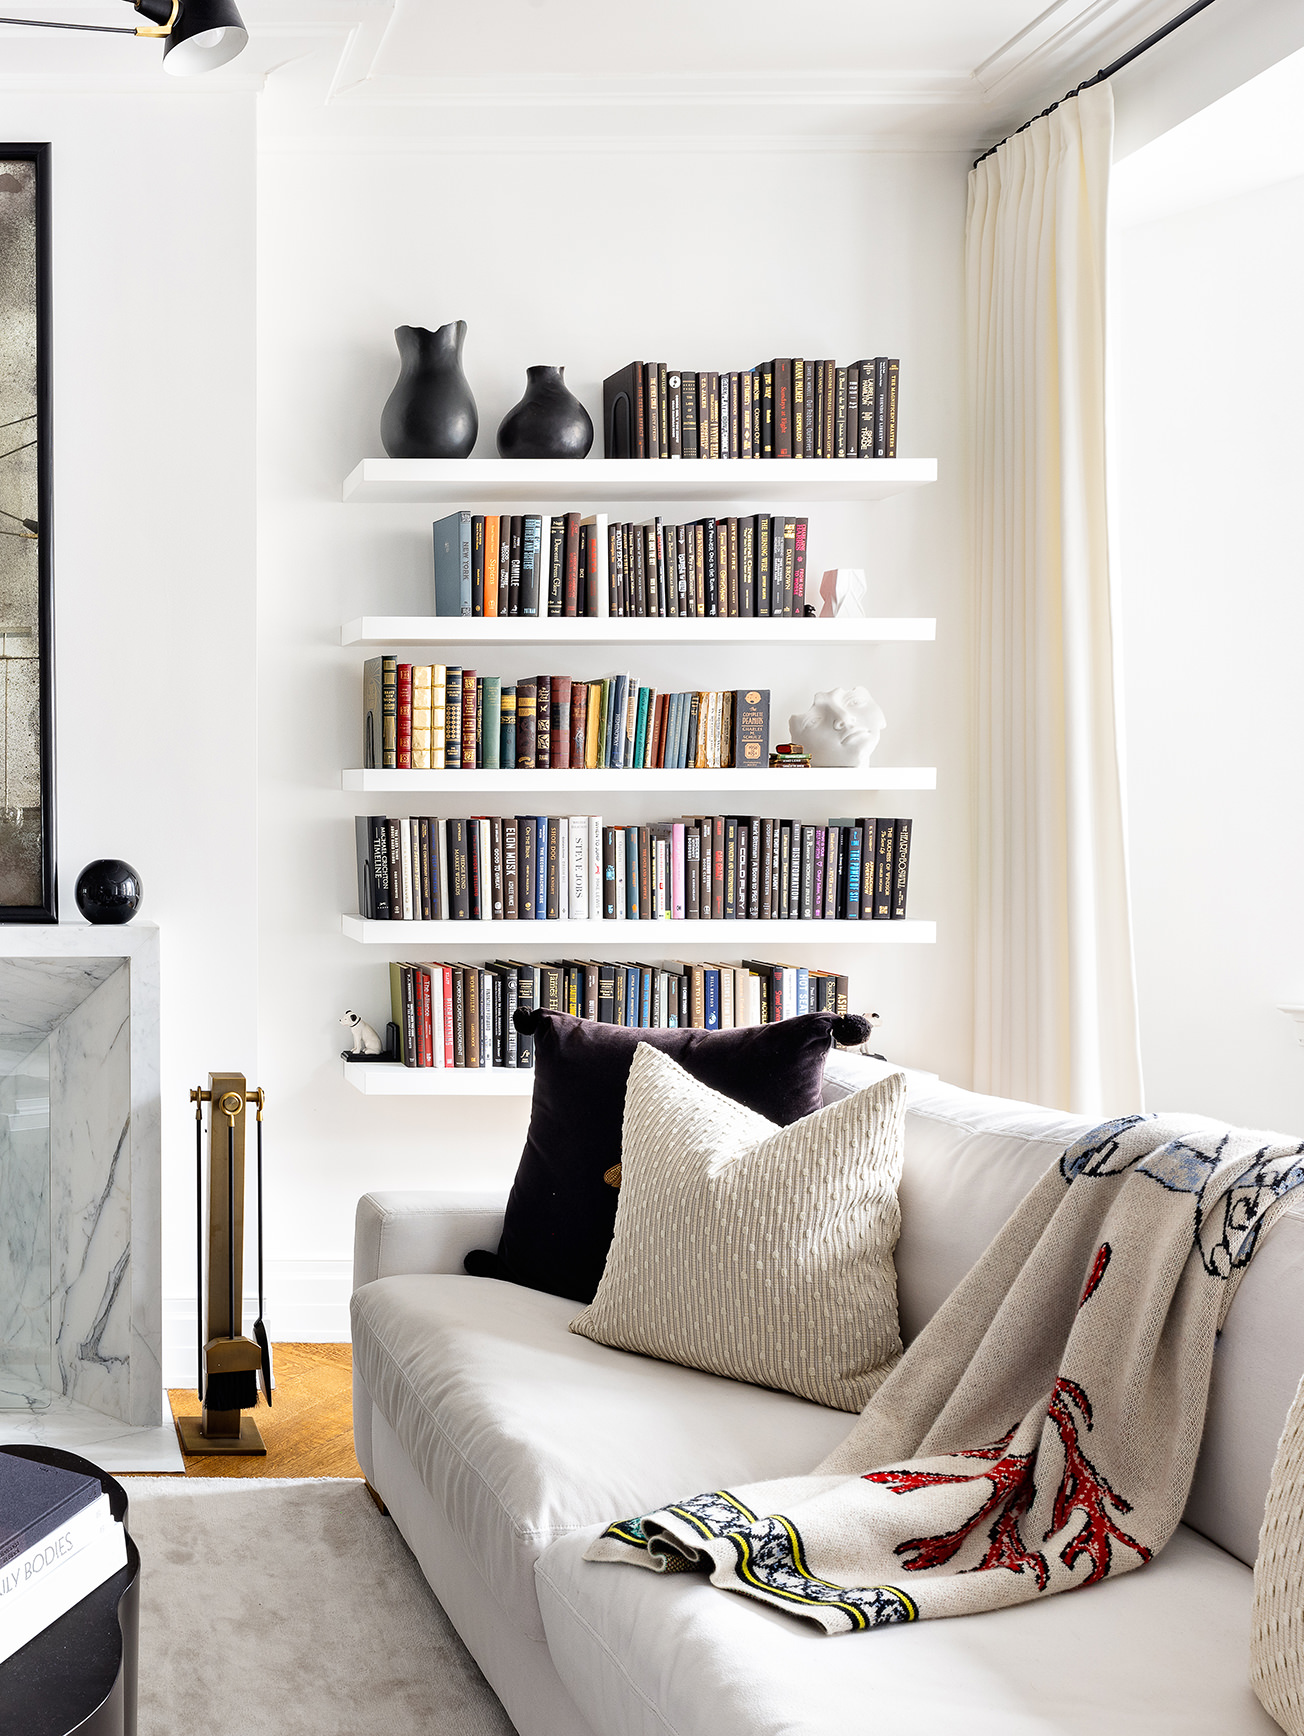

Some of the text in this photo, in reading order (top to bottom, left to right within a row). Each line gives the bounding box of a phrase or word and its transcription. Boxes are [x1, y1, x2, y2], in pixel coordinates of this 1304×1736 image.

[795, 361, 803, 403] DIANA PALMER
[488, 558, 496, 585] Sapiens
[511, 559, 520, 587] CAMILLE
[552, 578, 561, 597] Glory
[613, 713, 621, 747] HEMINGWAY
[742, 717, 764, 725] PEANUTS
[374, 838, 382, 879] TIMELINE
[506, 827, 516, 876] ELON MUSK
[715, 850, 723, 881] CAR CRAZY
[494, 864, 500, 872] TO
[575, 837, 583, 899] STEVE JOBS
[791, 847, 800, 901] DISINFORMATION
[849, 850, 860, 902] THE POWER OF SIX
[548, 972, 559, 997] James
[695, 987, 701, 997] TO
[799, 974, 808, 1014] HOT SEAT
[445, 1016, 453, 1046] ANYTHING
[24, 1531, 74, 1581] BODIES
